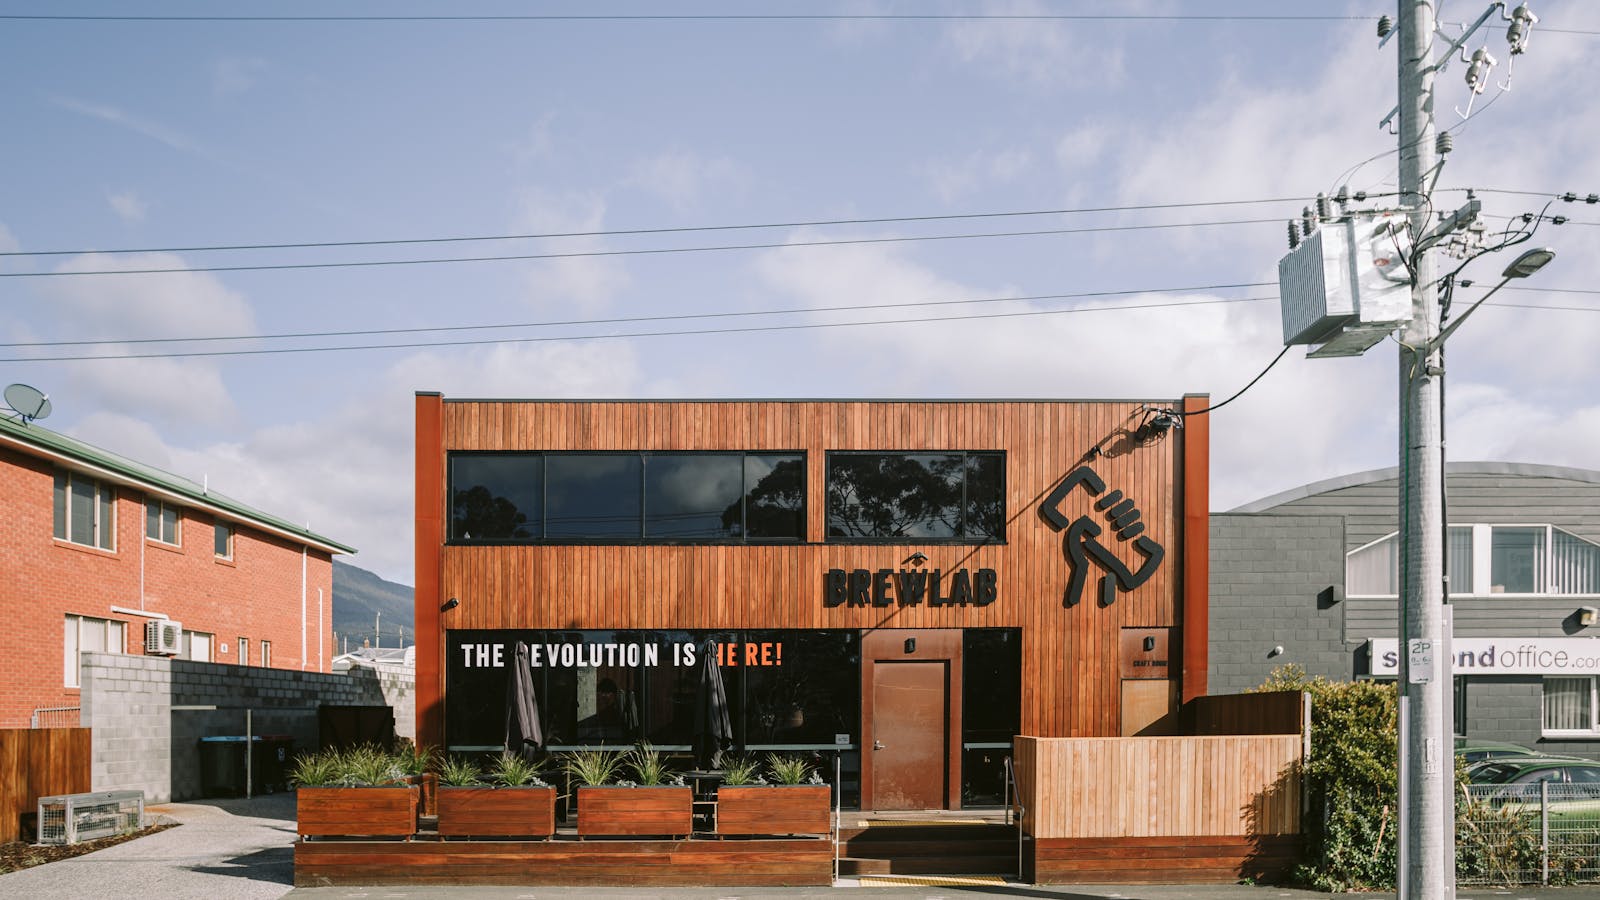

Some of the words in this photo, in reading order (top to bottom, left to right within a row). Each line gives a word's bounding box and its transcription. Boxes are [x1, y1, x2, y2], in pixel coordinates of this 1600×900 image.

[825, 568, 997, 606] BREWLAB
[460, 642, 505, 668] THE
[522, 642, 658, 668] EVOLUTION
[673, 642, 696, 668] IS
[1412, 641, 1431, 654] 2P
